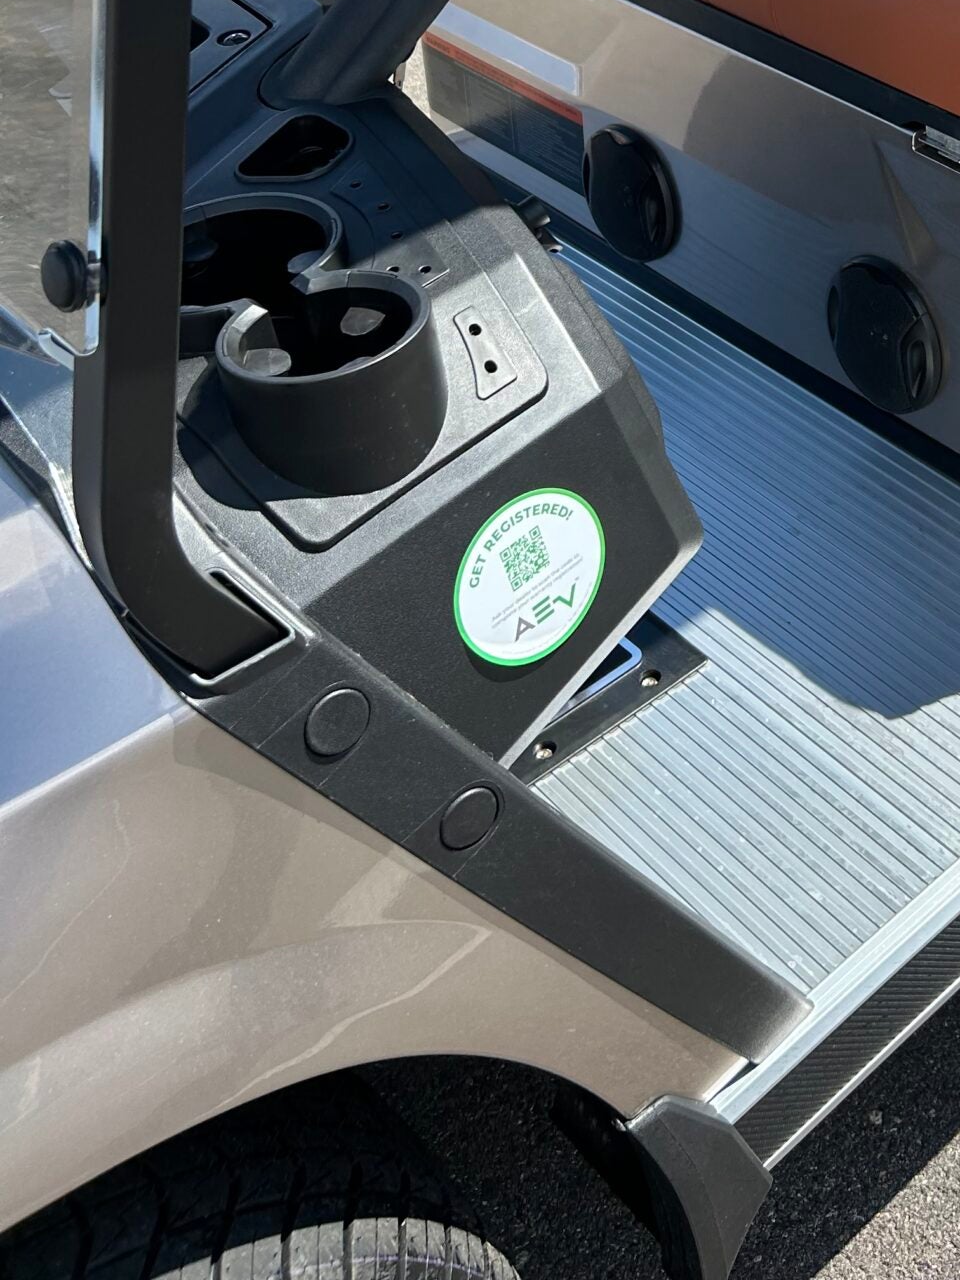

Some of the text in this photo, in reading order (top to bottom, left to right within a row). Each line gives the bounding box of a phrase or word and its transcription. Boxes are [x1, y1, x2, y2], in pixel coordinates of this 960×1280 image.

[469, 554, 487, 589] GET
[483, 503, 574, 552] REGISTERED!
[514, 582, 577, 643] AEV
